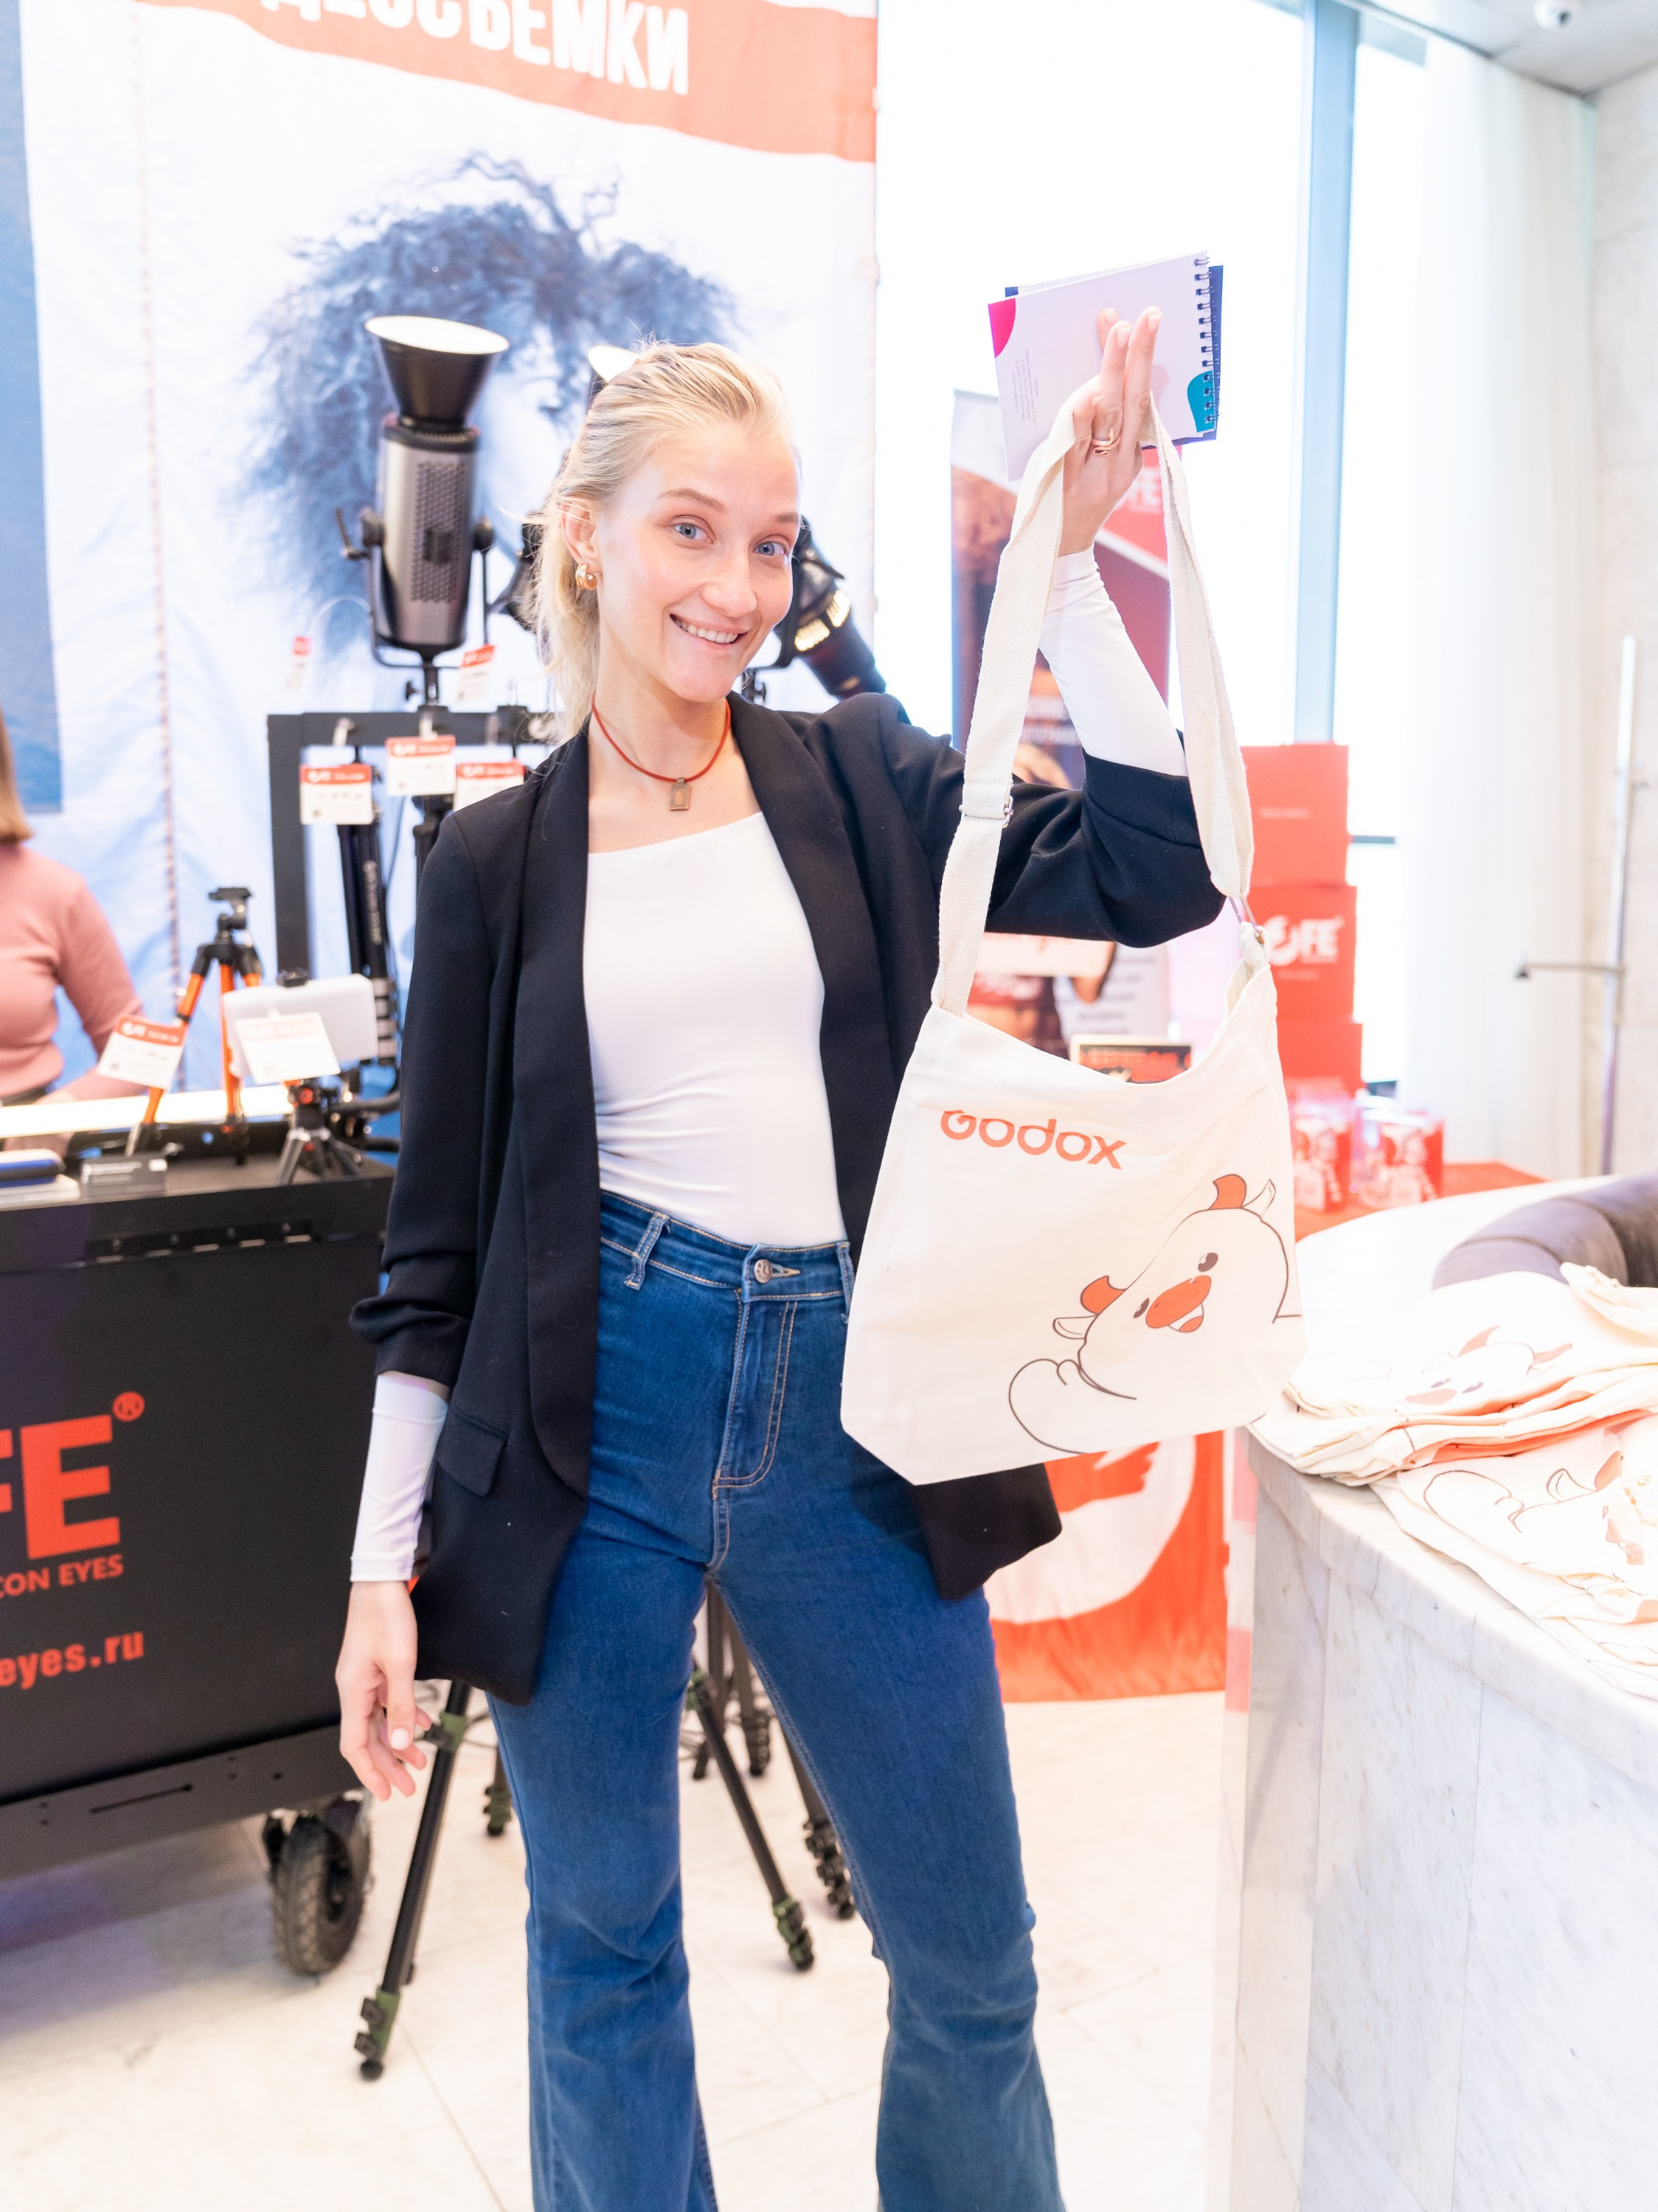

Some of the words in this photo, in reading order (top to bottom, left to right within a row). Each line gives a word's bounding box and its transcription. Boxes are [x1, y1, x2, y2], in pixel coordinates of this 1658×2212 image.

[261, 0, 688, 95] ЪЕМКИ
[940, 1110, 1127, 1169] Godox
[0, 1414, 120, 1560] E
[0, 1567, 50, 1599] ON
[58, 1554, 124, 1586] EYES
[0, 1631, 144, 1689] eyes.ru
